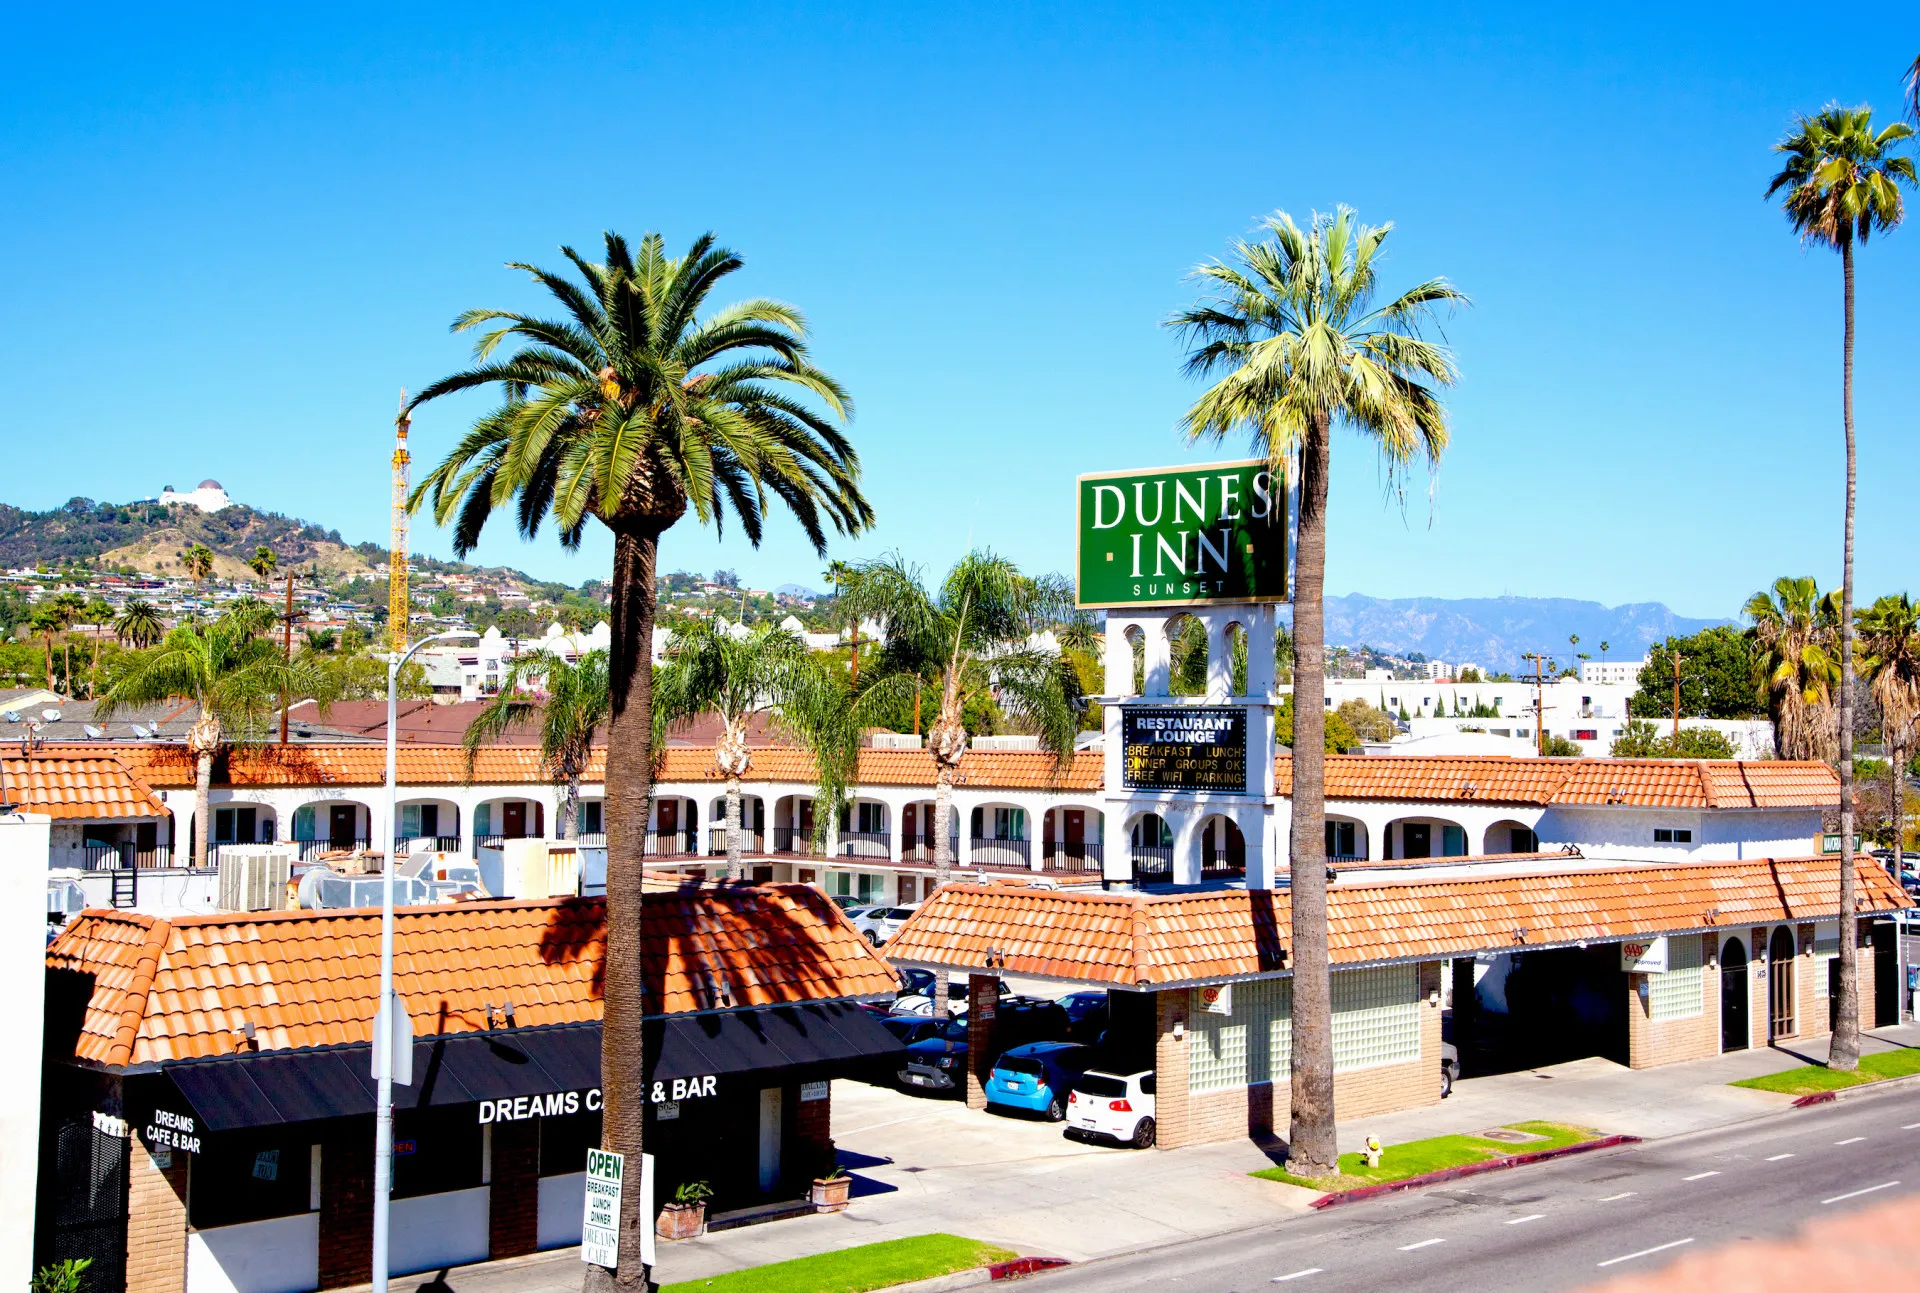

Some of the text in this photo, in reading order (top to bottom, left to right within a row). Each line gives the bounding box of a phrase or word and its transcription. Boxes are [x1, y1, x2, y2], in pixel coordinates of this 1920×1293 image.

[1091, 471, 1273, 530] DUNES
[1129, 528, 1233, 578] INN
[1133, 580, 1224, 596] SUNSET
[1136, 717, 1234, 731] RESTAURANT
[1154, 730, 1216, 743] LOUNGE
[1128, 745, 1242, 758] BREAKFAST LUNCH
[1127, 757, 1241, 770] DINNER GROUPS OK
[1127, 770, 1242, 783] FREE WIFI PARKING
[478, 1091, 580, 1124] DREAMS
[651, 1081, 666, 1103] &
[672, 1075, 717, 1101] BAR
[155, 1109, 194, 1133] DREAMS
[147, 1125, 201, 1154] CAFE & BAR
[588, 1151, 621, 1180] OPEN
[587, 1181, 620, 1198] BREAKFAST
[592, 1196, 611, 1211] LUNCH
[590, 1210, 612, 1226] DINNER
[584, 1227, 616, 1248] DREAMS
[588, 1247, 609, 1265] CAFE
